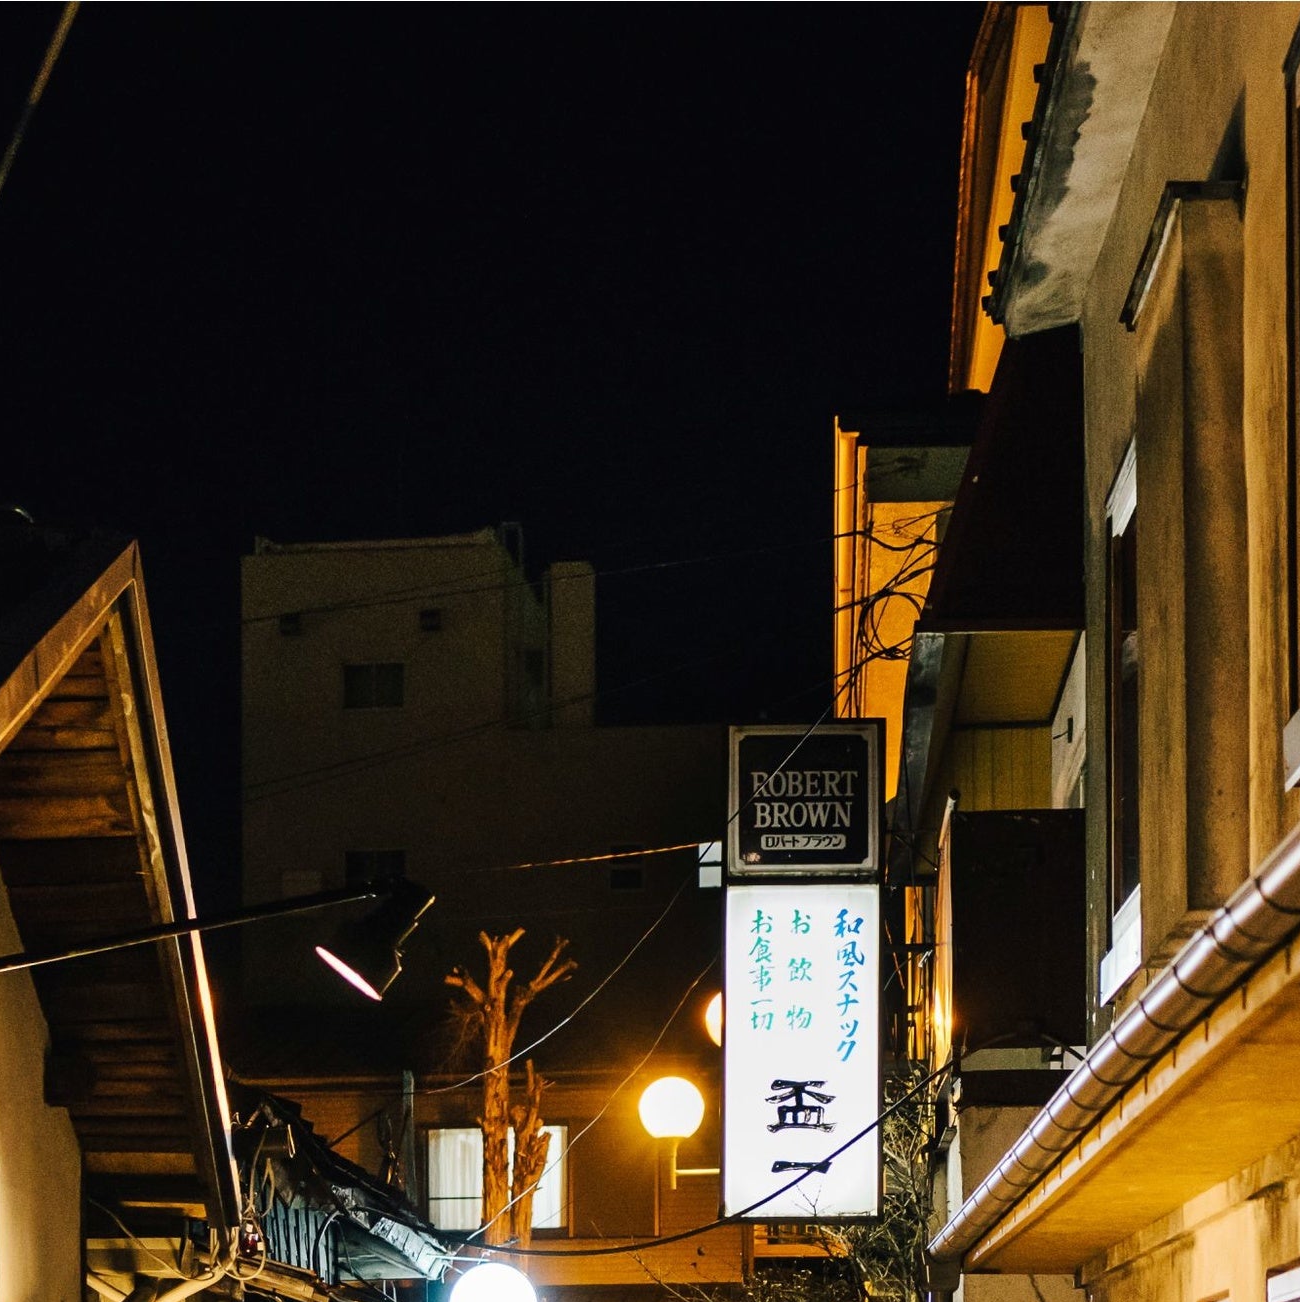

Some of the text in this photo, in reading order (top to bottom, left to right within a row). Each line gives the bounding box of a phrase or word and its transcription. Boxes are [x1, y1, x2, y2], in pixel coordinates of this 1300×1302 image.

[751, 771, 858, 797] ROBERT
[754, 802, 853, 828] BROWN
[749, 909, 775, 1030] お食事一切
[786, 909, 813, 1030] お飲物
[834, 908, 865, 1062] 和風スナック
